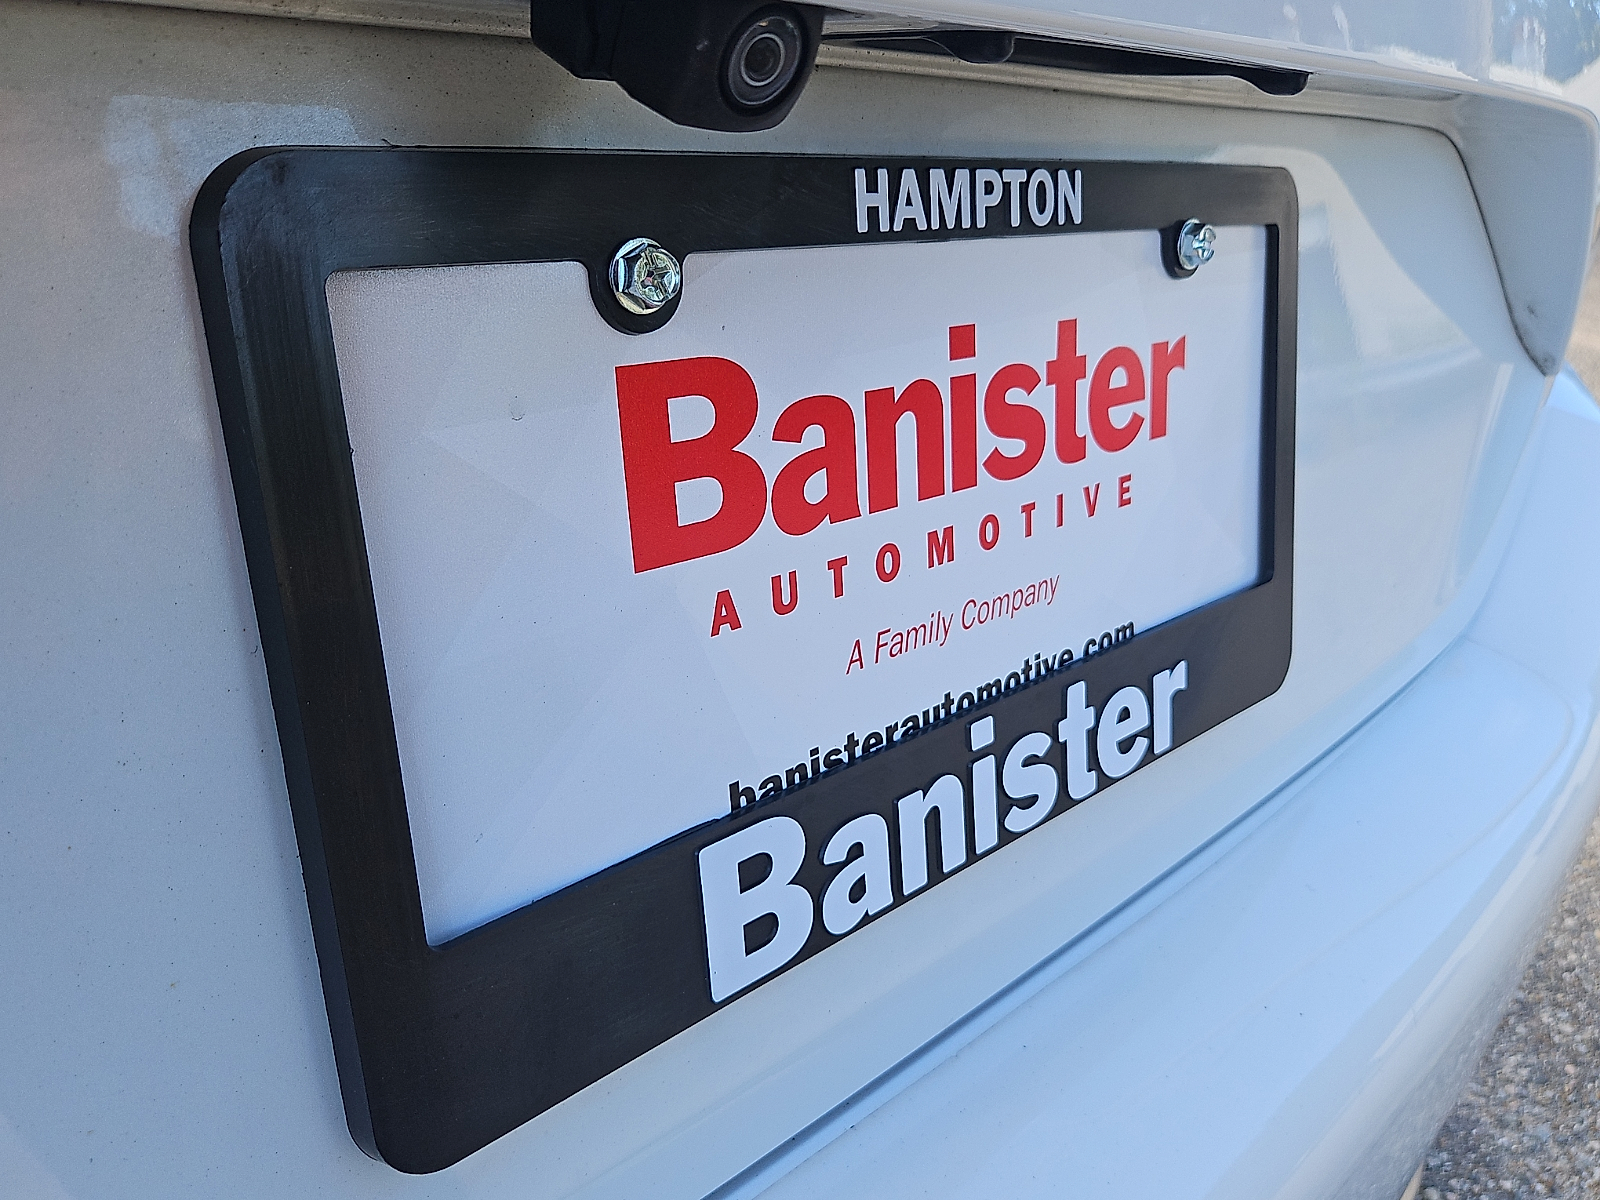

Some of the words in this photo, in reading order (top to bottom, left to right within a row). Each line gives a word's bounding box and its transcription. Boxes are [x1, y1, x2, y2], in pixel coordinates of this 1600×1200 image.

[854, 167, 1083, 234] HAMPTON
[614, 318, 1187, 574] Banister
[710, 474, 1133, 638] AUTOMOTIVE
[845, 638, 865, 676] A
[874, 610, 954, 664] Family
[961, 575, 1061, 629] Company
[728, 620, 1137, 814] banisterautomotivecom
[697, 660, 1189, 1003] Banister
